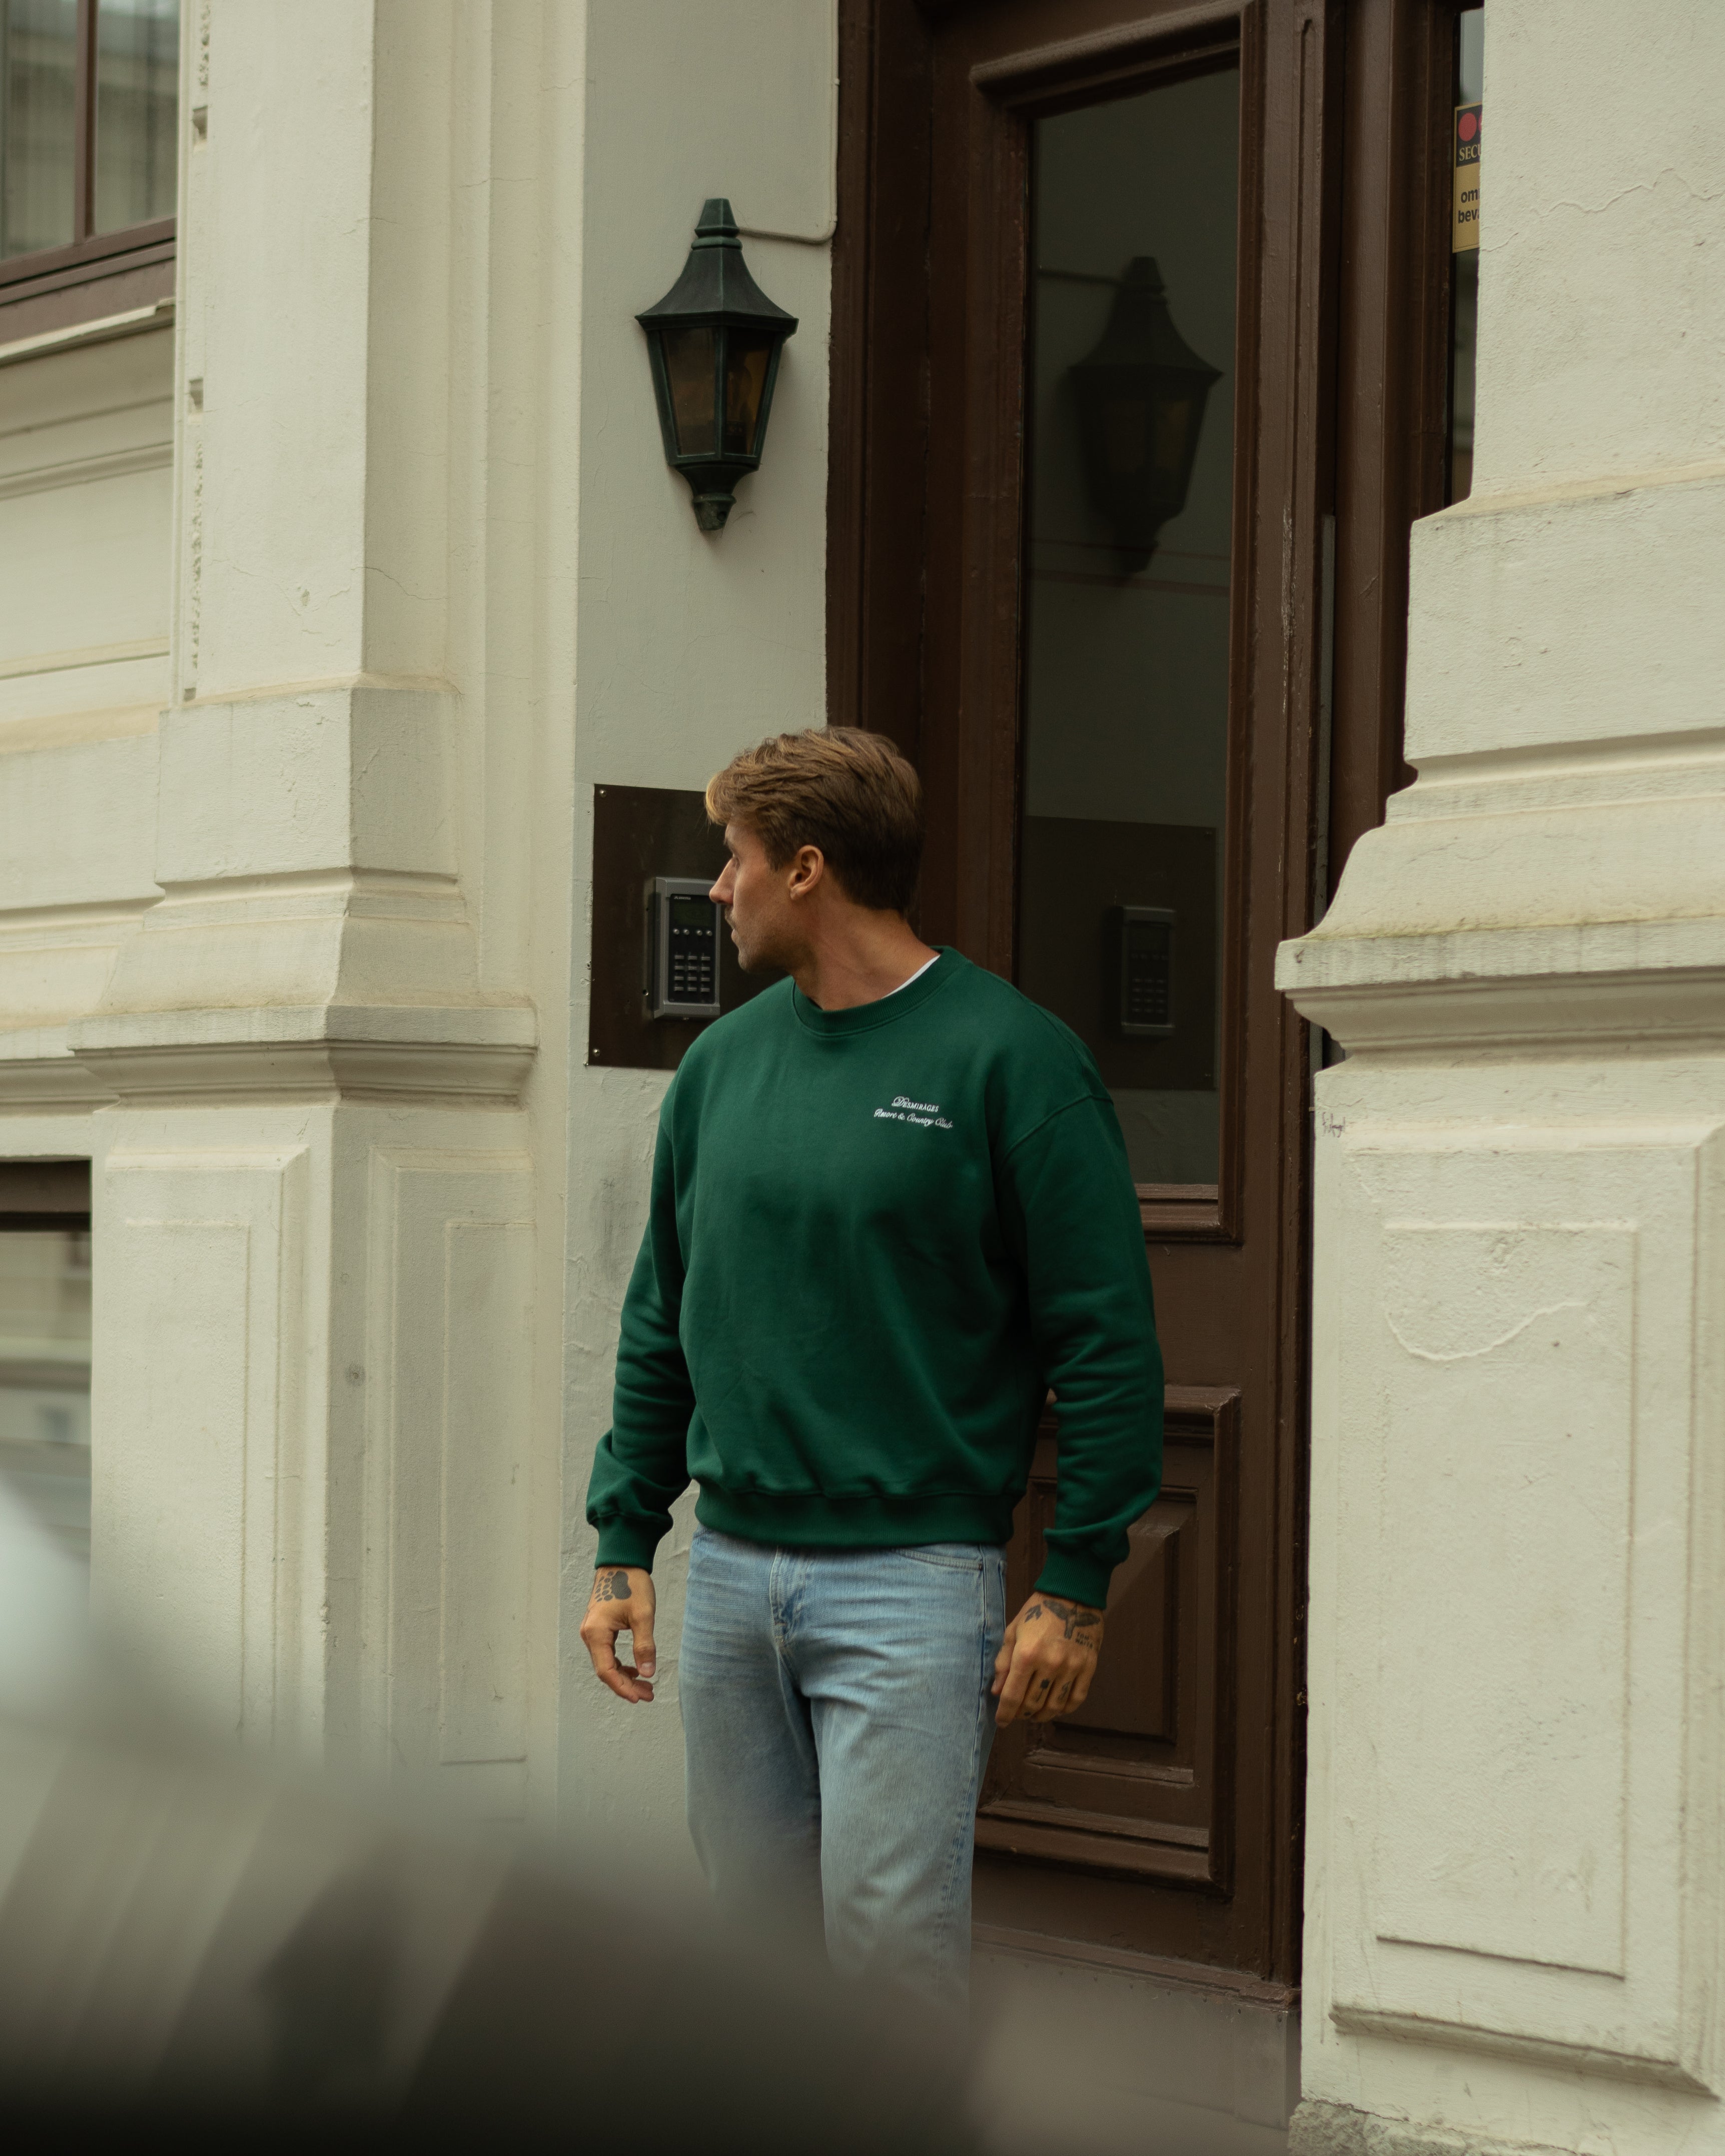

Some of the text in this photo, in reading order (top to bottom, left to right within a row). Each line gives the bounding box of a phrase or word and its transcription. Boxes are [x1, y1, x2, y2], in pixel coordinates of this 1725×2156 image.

[892, 1096, 939, 1113] DESMIRAGES
[874, 1108, 953, 1129] Resort & Country Club
